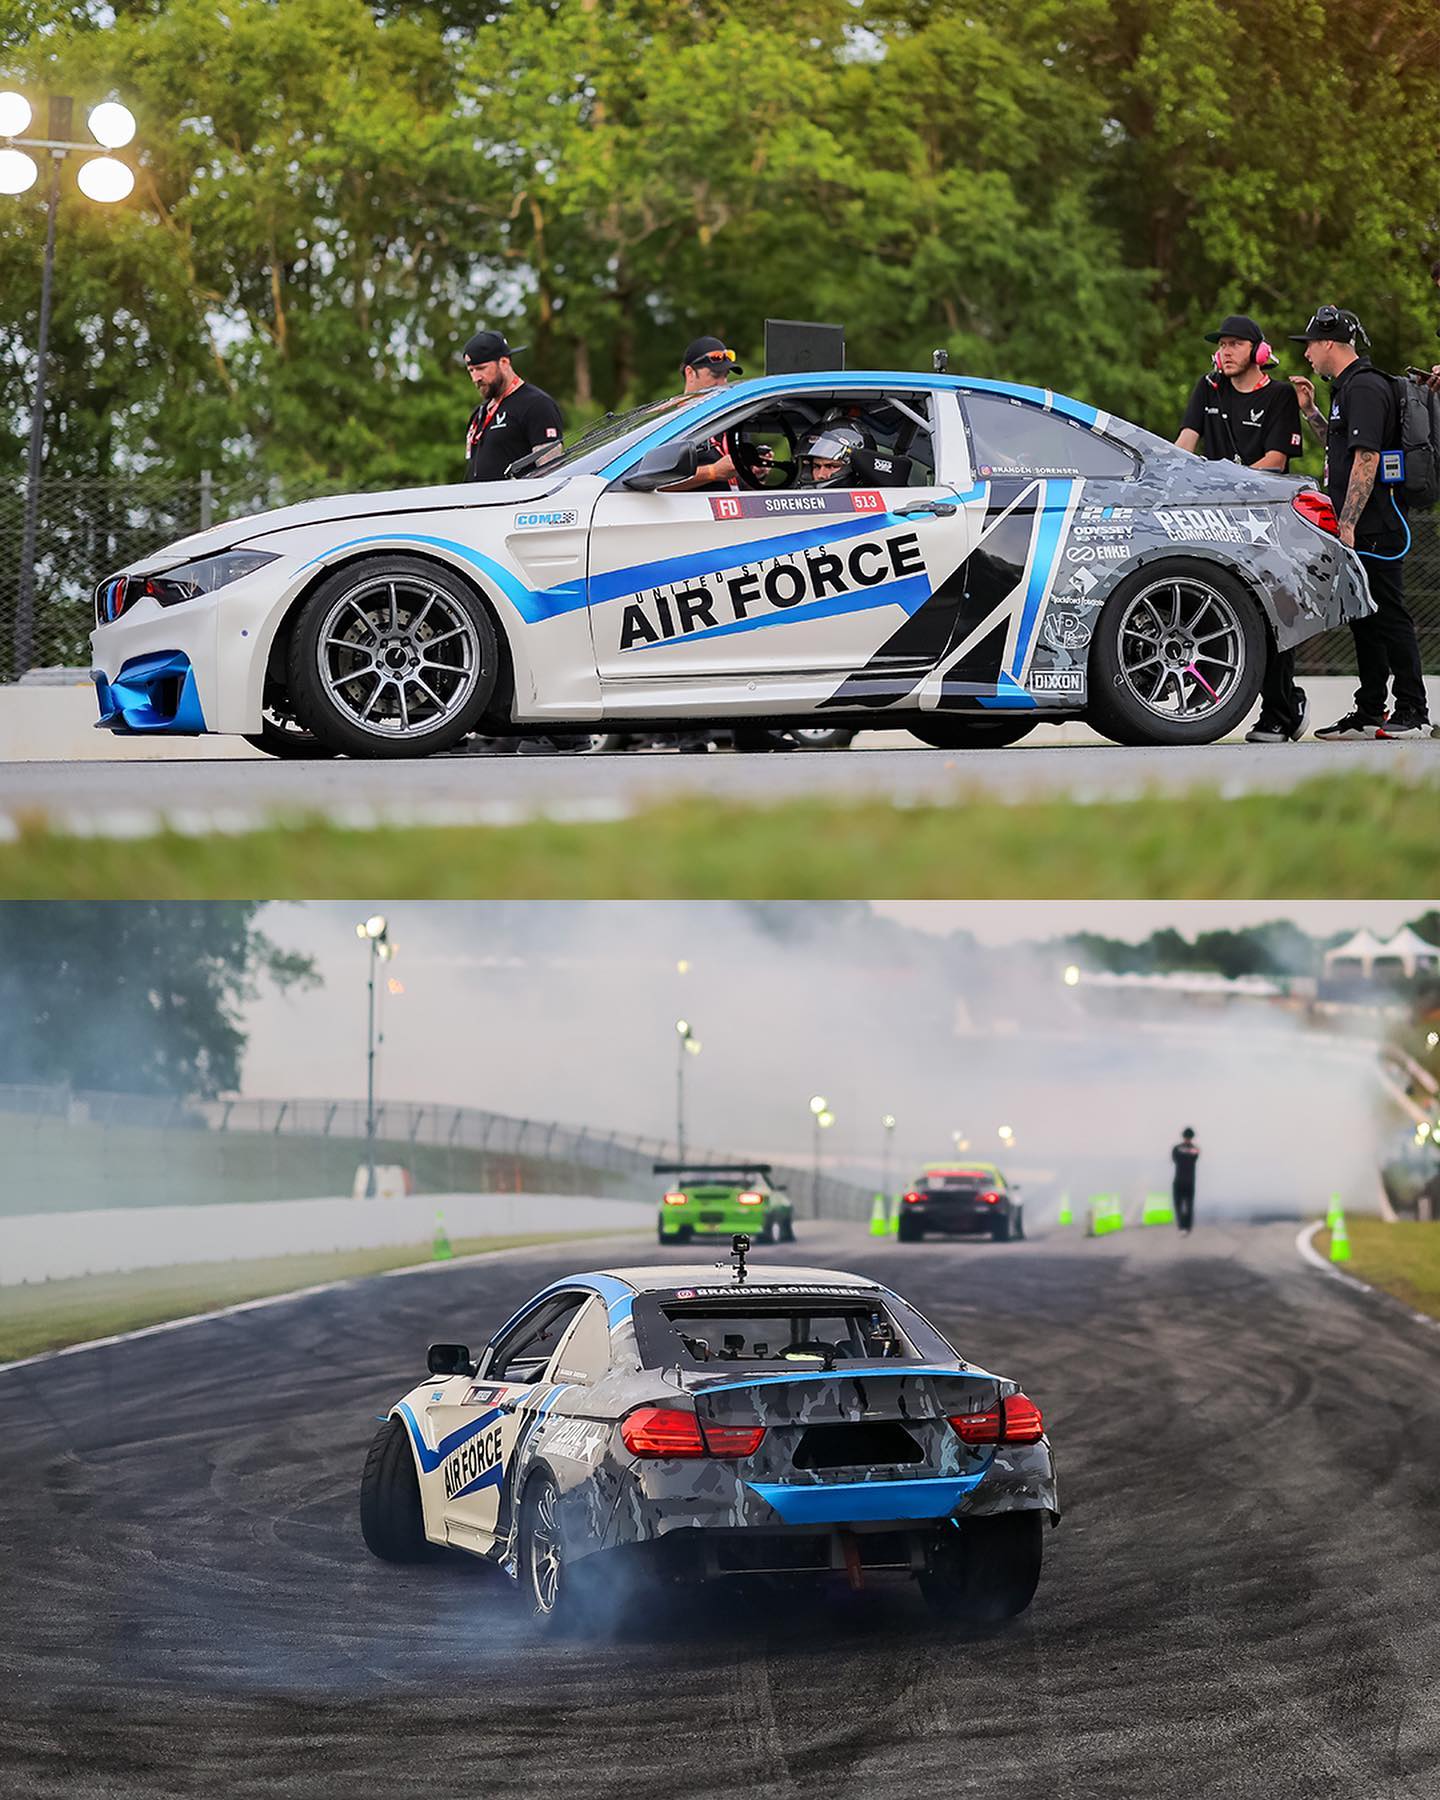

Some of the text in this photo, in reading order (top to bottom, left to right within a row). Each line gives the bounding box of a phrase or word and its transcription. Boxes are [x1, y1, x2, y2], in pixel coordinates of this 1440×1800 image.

[719, 499, 739, 517] FD
[765, 497, 826, 512] SORENSEN
[855, 495, 878, 509] 513
[517, 513, 562, 525] COMP
[1153, 508, 1239, 532] PEDAL
[1073, 525, 1134, 536] ODYSSEY
[1166, 529, 1246, 544] COMMANDER
[1096, 545, 1132, 560] ENKEI
[635, 545, 828, 604] UNITED STATES
[619, 532, 927, 650] AIR FORCE
[1034, 674, 1080, 689] DIXXON
[445, 1457, 463, 1499] AIR
[462, 1426, 503, 1485] FORCE
